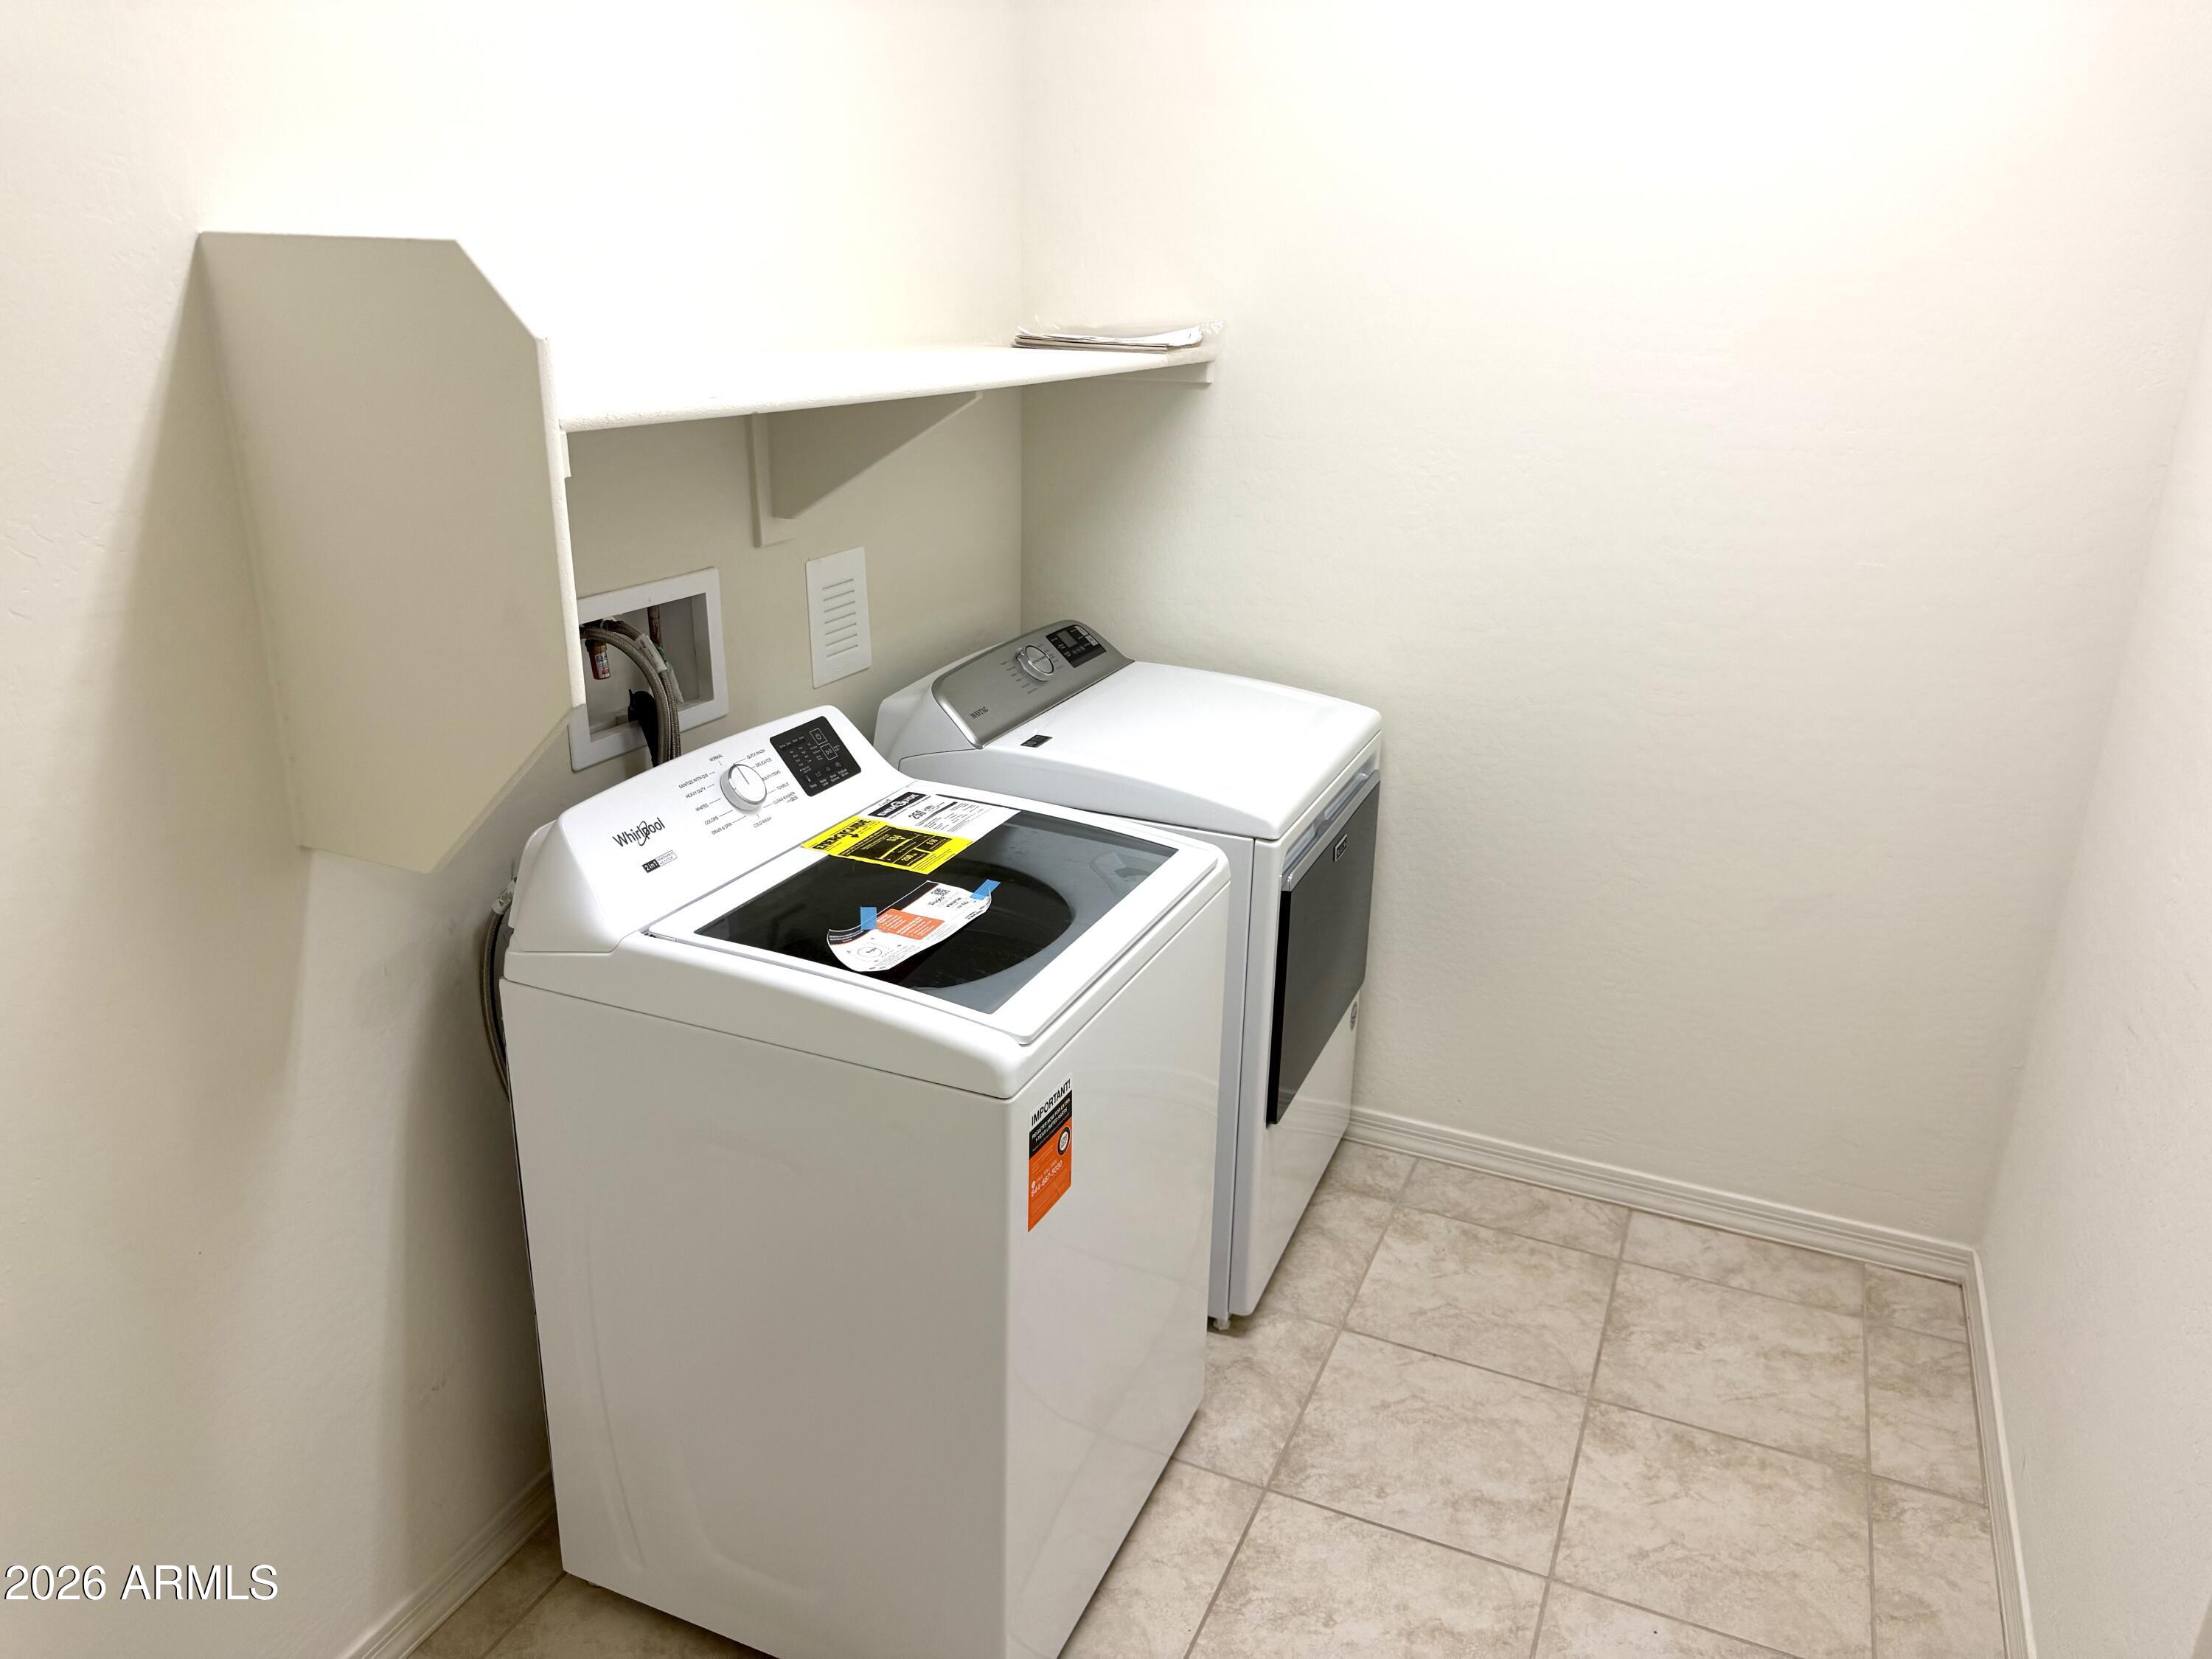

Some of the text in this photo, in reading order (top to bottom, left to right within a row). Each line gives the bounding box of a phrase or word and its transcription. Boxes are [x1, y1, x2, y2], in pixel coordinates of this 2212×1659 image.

[970, 706, 989, 719] MAYTAG
[709, 754, 723, 762] NORMAL
[755, 757, 772, 768] DELICATES
[776, 782, 790, 790] TOWELS
[695, 803, 709, 812] WHITES
[704, 815, 719, 825] COLORS
[908, 810, 927, 820] 250
[612, 817, 665, 846] Whirlpool
[711, 827, 723, 835] DRAIN
[1032, 1078, 1071, 1126] IMPORTANT!
